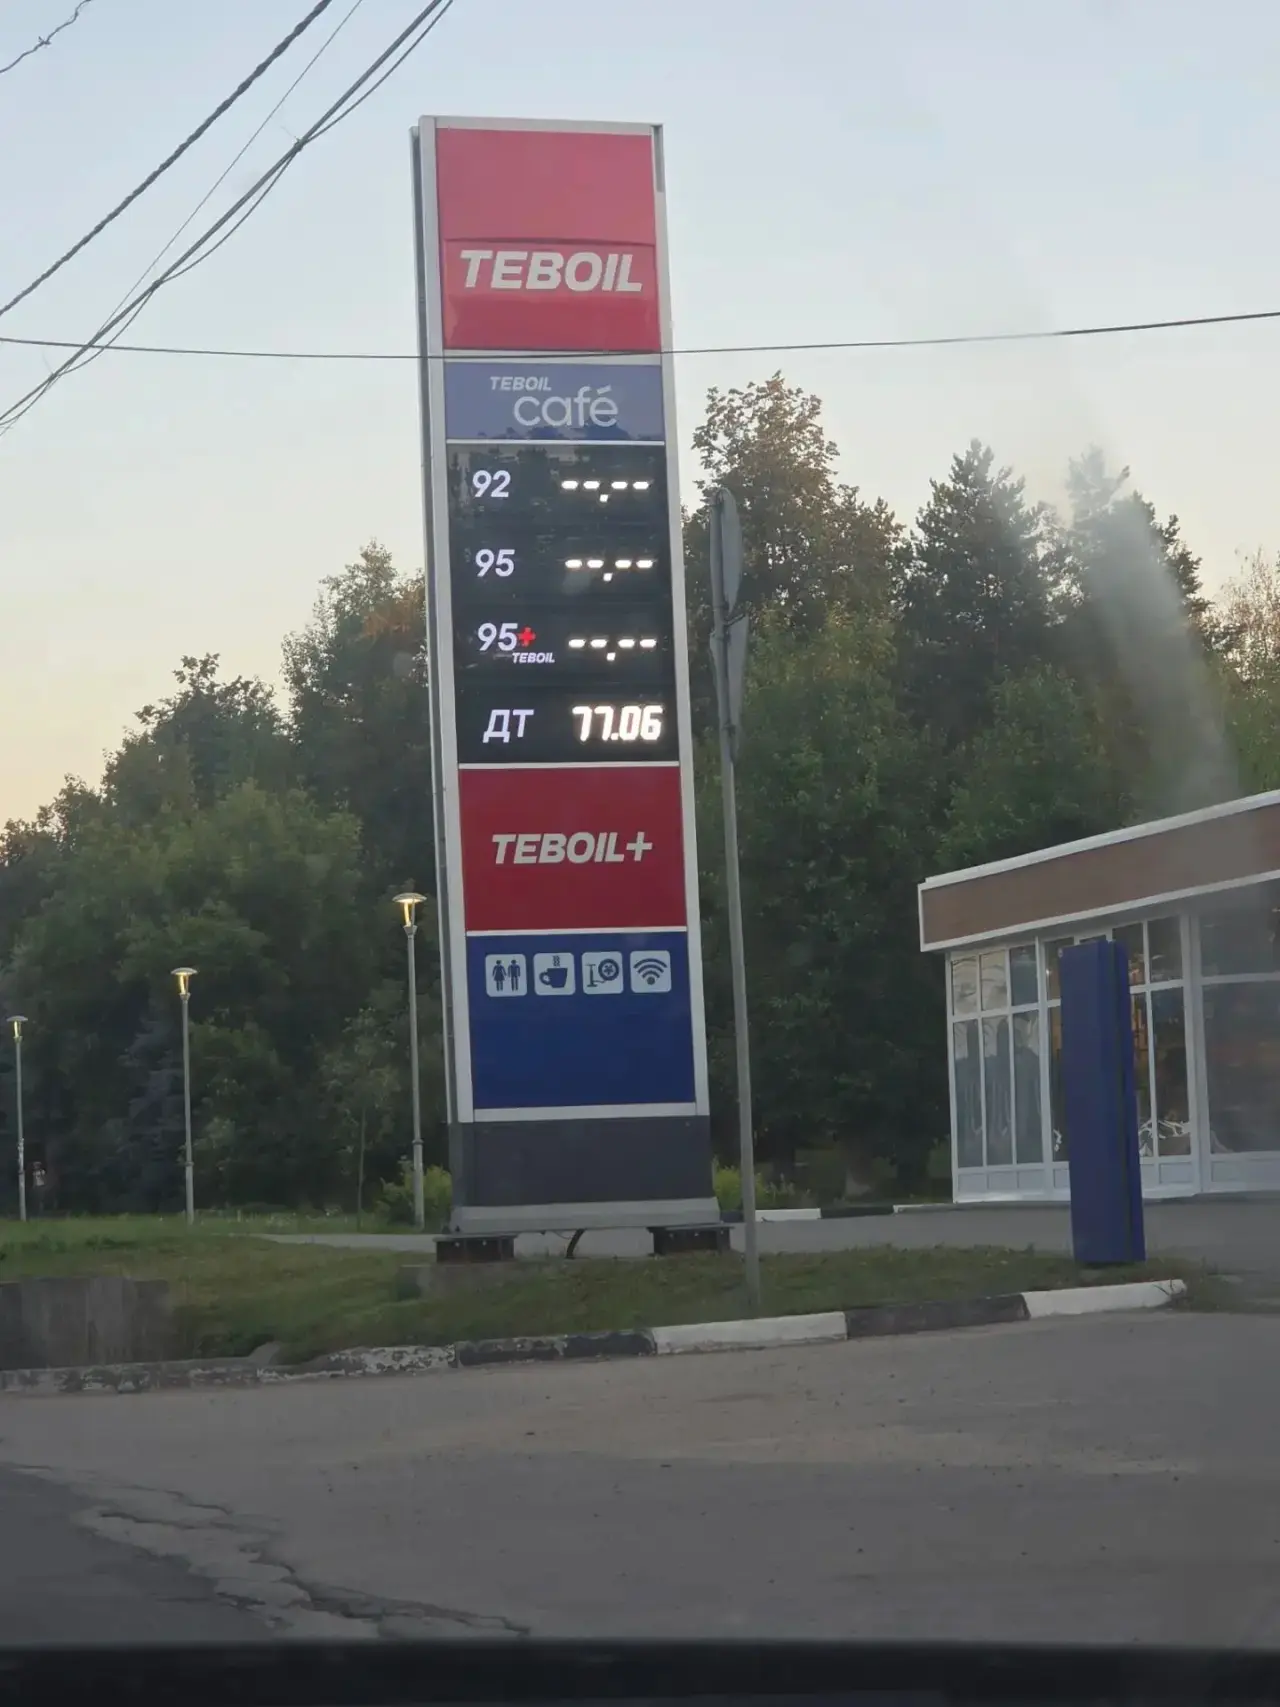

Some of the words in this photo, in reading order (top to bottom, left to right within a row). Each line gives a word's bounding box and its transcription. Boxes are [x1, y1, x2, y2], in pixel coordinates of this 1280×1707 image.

[460, 249, 643, 292] TEBOIL
[489, 376, 552, 392] TEBOIL
[513, 385, 619, 427] café
[472, 470, 511, 498] 92
[475, 549, 515, 577] 95
[512, 652, 555, 664] TEBOIL
[482, 709, 534, 743] ДТ
[571, 704, 665, 742] 77.06
[491, 831, 653, 865] TEBOIL+
